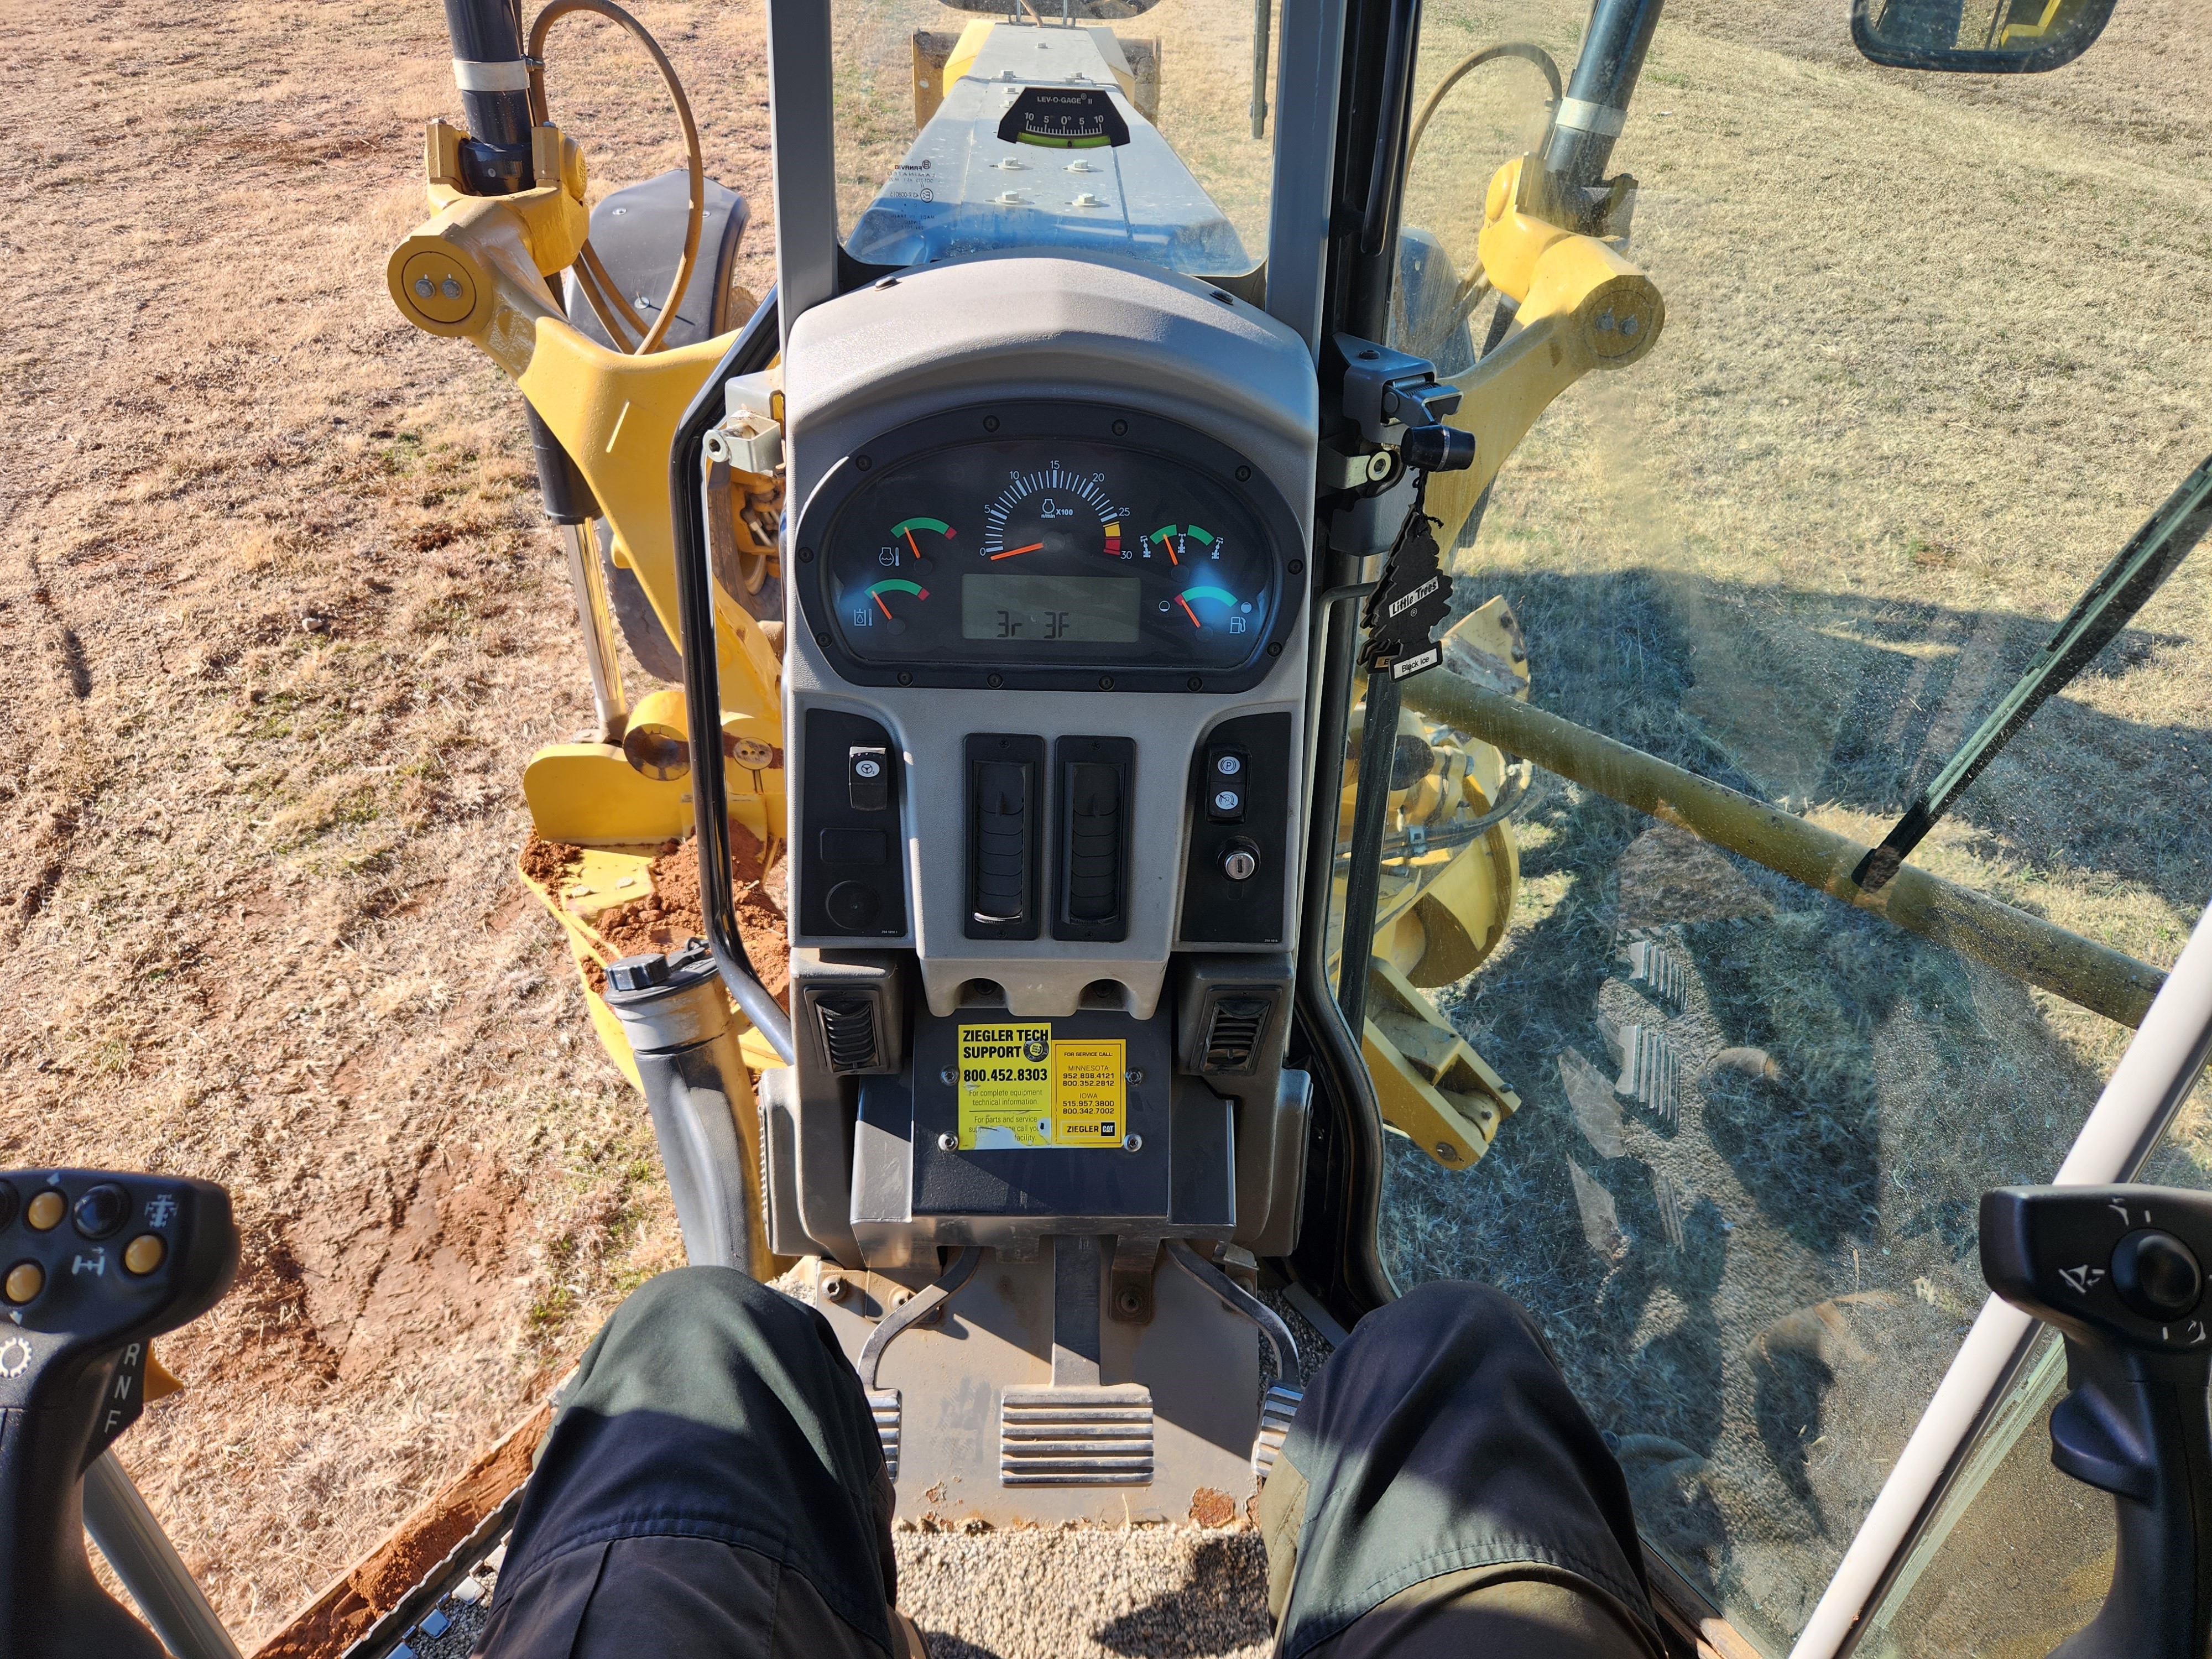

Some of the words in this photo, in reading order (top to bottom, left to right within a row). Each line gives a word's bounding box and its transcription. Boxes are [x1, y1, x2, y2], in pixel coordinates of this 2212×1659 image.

[1025, 112, 1034, 121] 10
[1094, 115, 1104, 123] 10
[1050, 460, 1060, 469] 15
[1010, 471, 1020, 480] 10
[1092, 473, 1105, 482] 20
[984, 504, 990, 514] 5
[1119, 507, 1130, 517] 25
[979, 547, 986, 556] 0
[1120, 551, 1133, 560] 30
[1392, 594, 1413, 615] Little
[1415, 581, 1437, 600] Trees
[1044, 611, 1070, 639] 3F
[1401, 660, 1419, 673] Black
[1420, 656, 1430, 666] Ice
[963, 1029, 1014, 1042] ZIEGLER
[1016, 1029, 1048, 1041] TECH
[963, 1046, 1022, 1059] SUPPORT
[963, 1068, 1047, 1082] 800.452.8303
[980, 1089, 1009, 1098] complete
[124, 1343, 140, 1366] R
[114, 1375, 132, 1400] N
[105, 1410, 121, 1433] F
